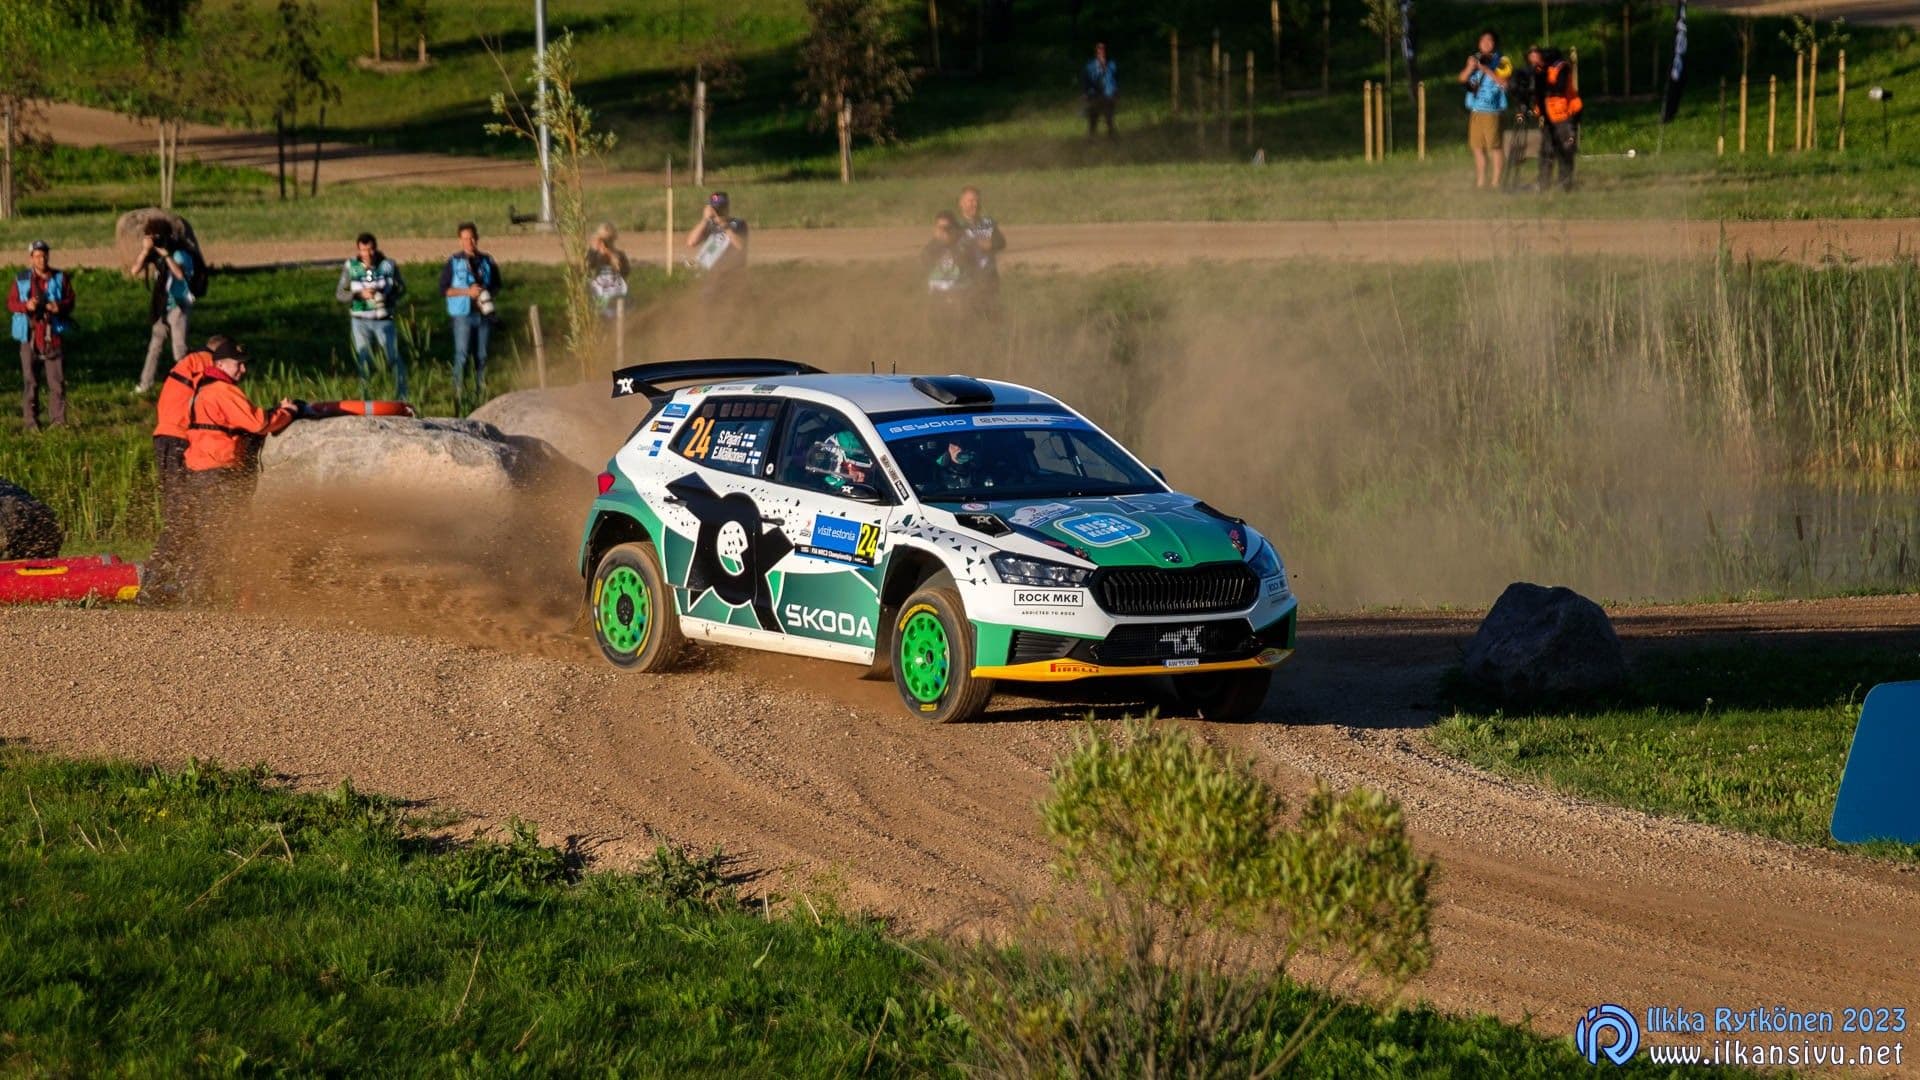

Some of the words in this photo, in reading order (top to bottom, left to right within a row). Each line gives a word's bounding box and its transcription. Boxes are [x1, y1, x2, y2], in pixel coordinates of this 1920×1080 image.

[889, 419, 967, 434] BEYOND
[683, 416, 715, 459] 24
[817, 525, 832, 537] visit
[832, 528, 856, 541] estonia
[857, 524, 879, 558] 24
[1018, 593, 1050, 602] ROCK
[1053, 594, 1079, 603] MKR
[1050, 662, 1099, 673] PIRELLI
